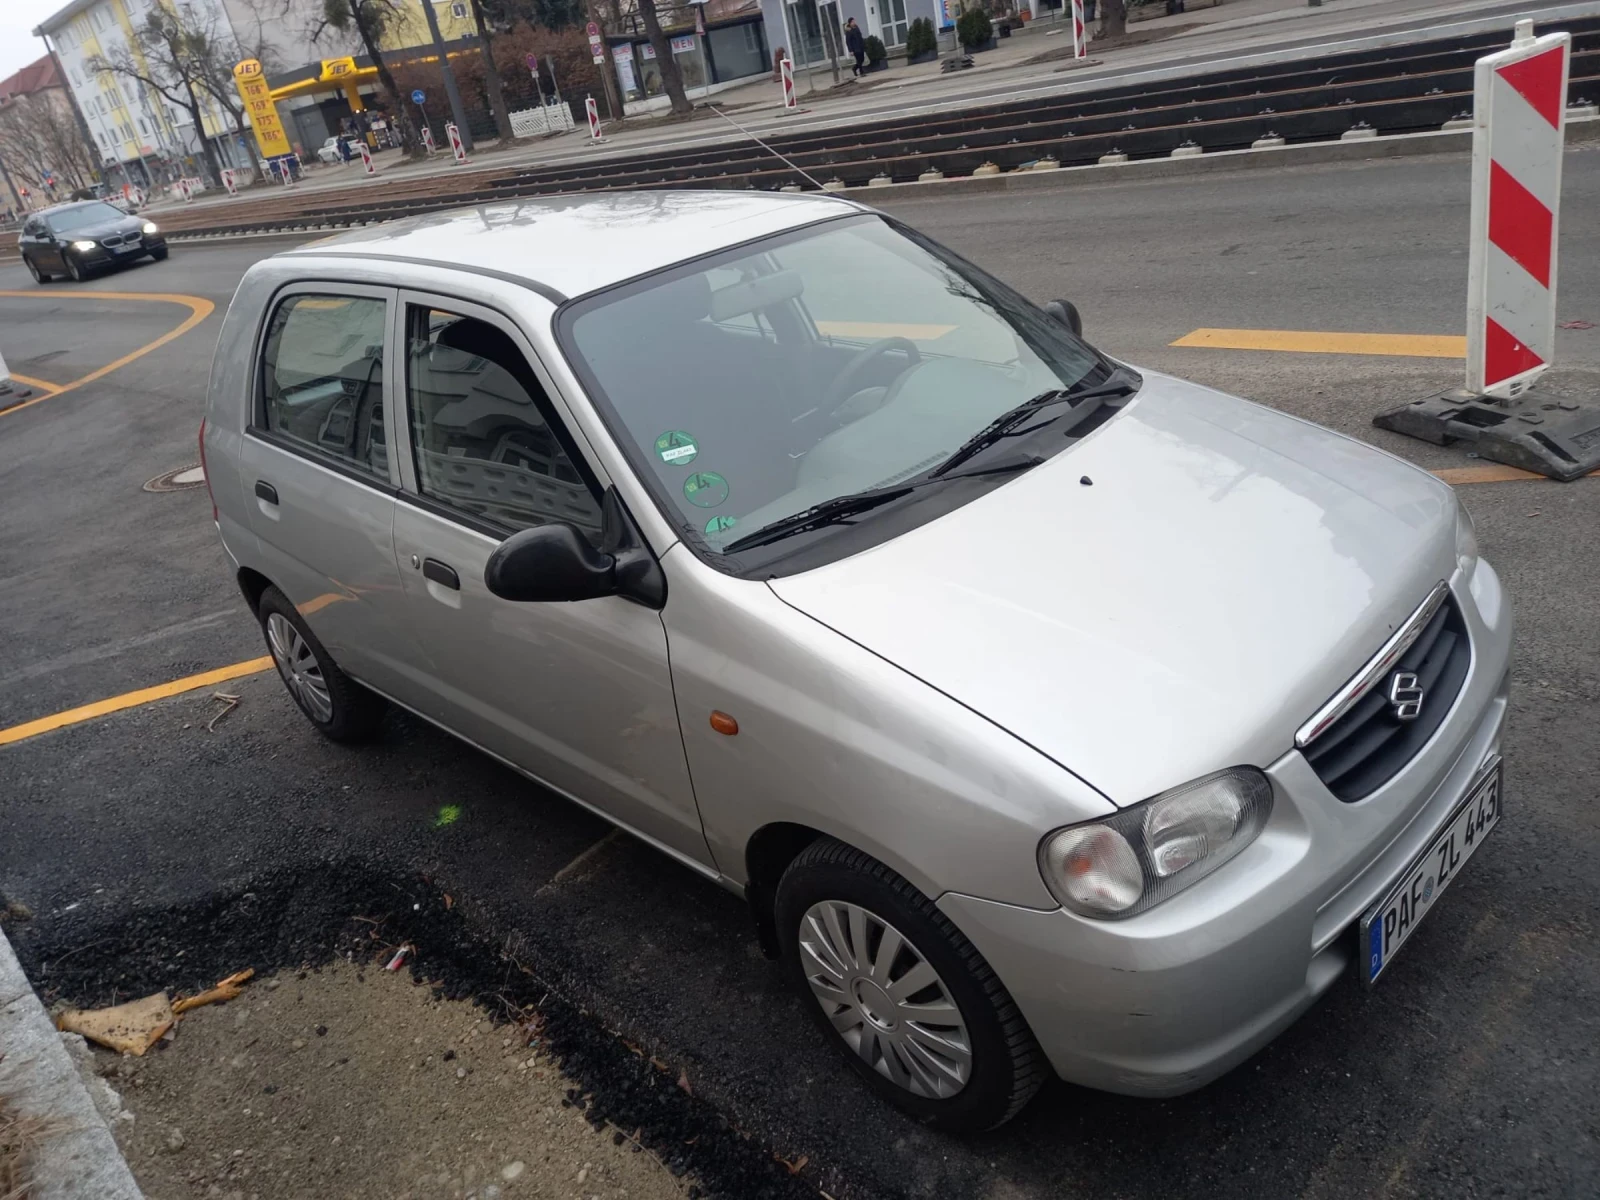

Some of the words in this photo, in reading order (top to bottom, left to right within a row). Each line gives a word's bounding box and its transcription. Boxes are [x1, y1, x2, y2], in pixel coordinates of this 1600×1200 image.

[239, 64, 258, 75] JET
[330, 64, 348, 75] JET
[1371, 953, 1378, 967] D
[1384, 872, 1424, 955] PAF
[1437, 833, 1460, 887] ZL
[1465, 780, 1497, 846] 443
